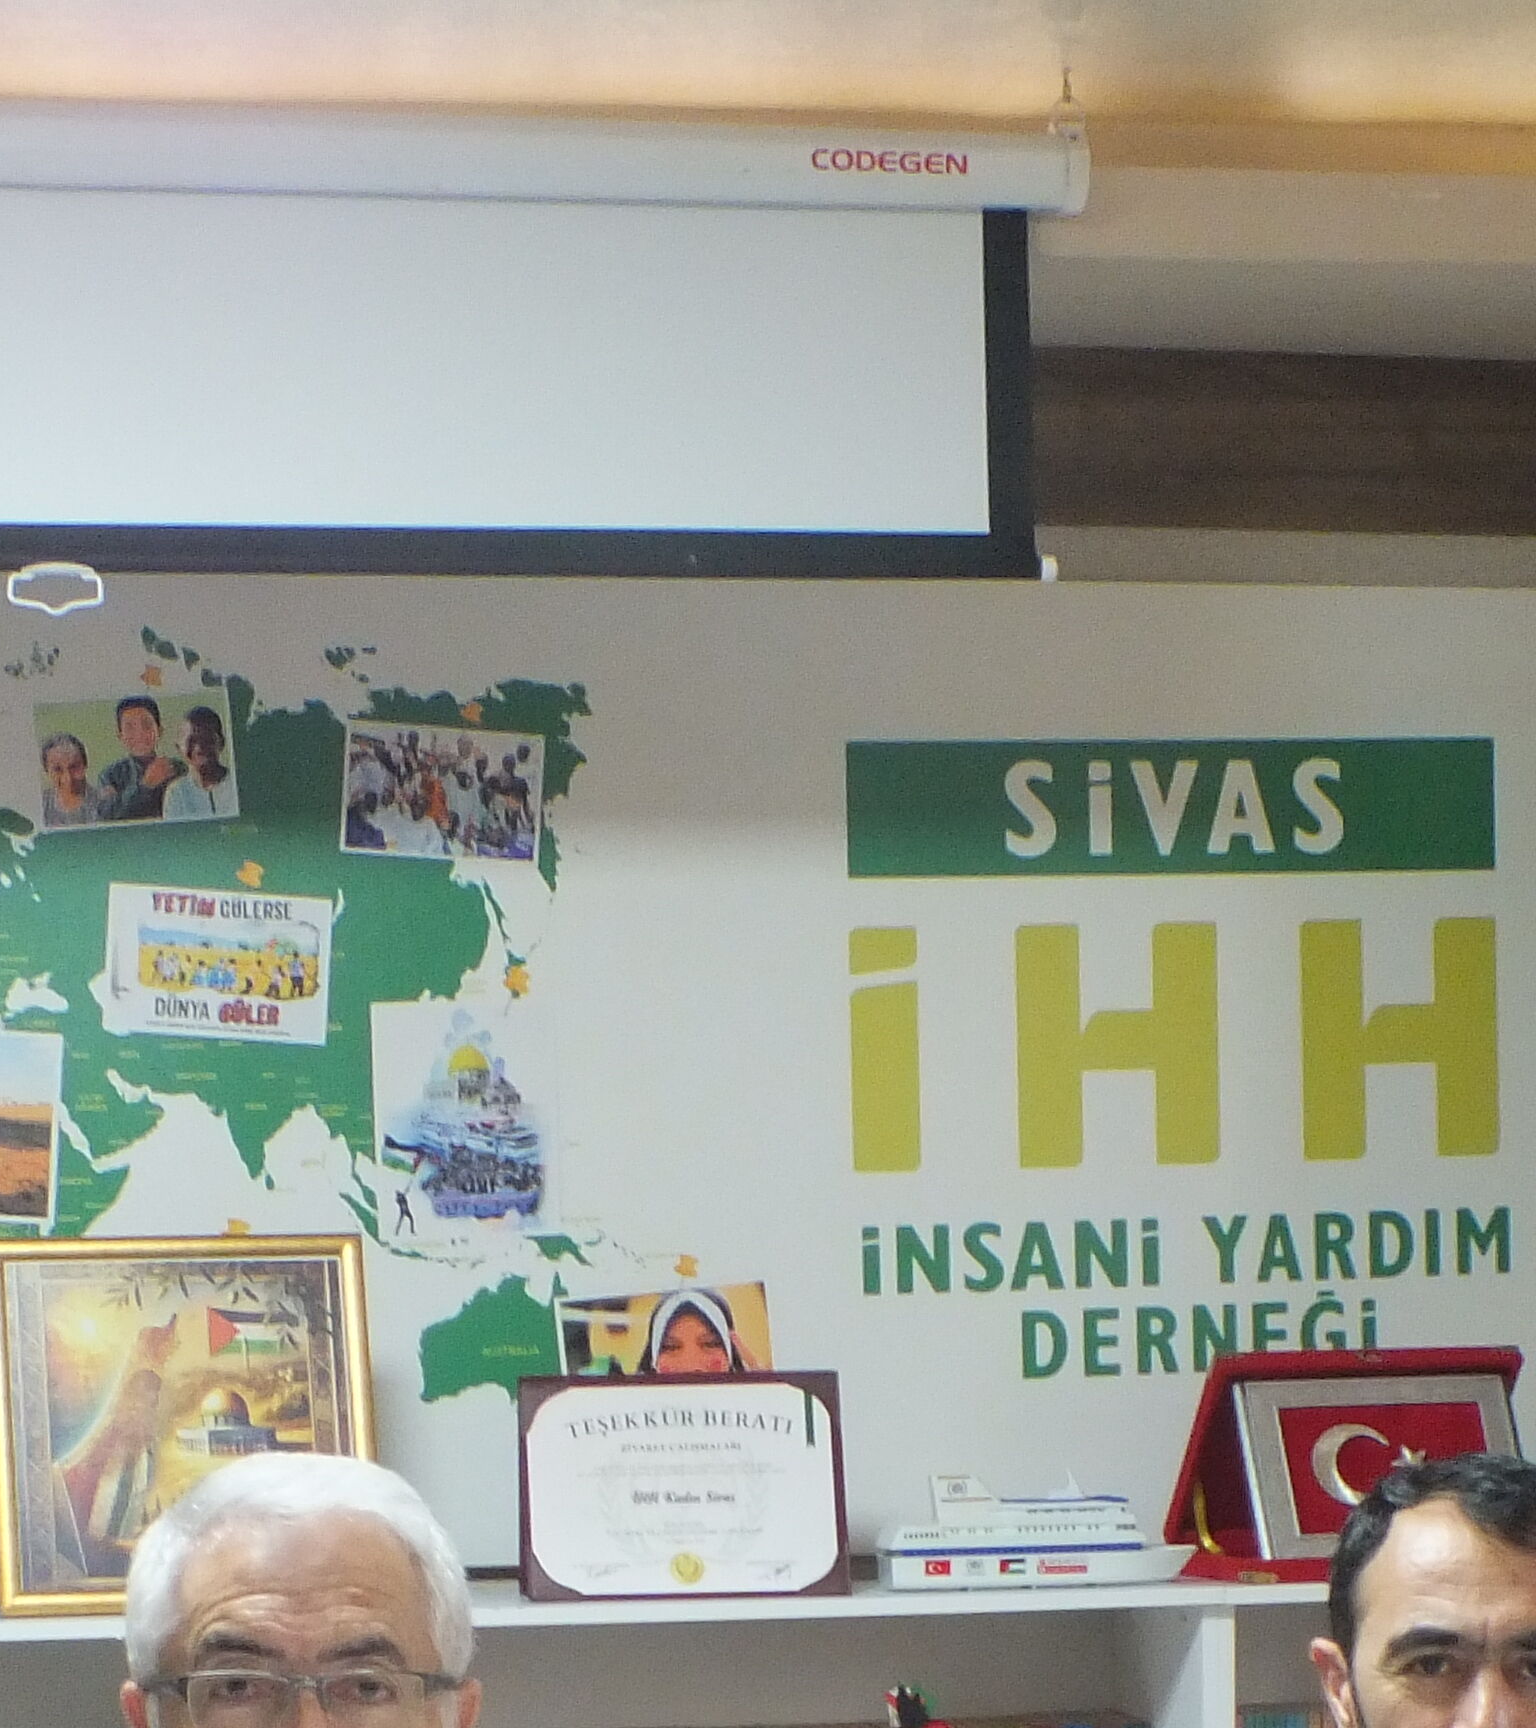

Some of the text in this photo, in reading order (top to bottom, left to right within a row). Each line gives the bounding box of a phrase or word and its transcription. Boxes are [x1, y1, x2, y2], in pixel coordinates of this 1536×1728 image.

[811, 147, 968, 175] CODEGEN
[154, 993, 211, 1021] DÜNYA
[1202, 1206, 1514, 1284] YARDIM
[704, 1409, 793, 1435] BERATI
